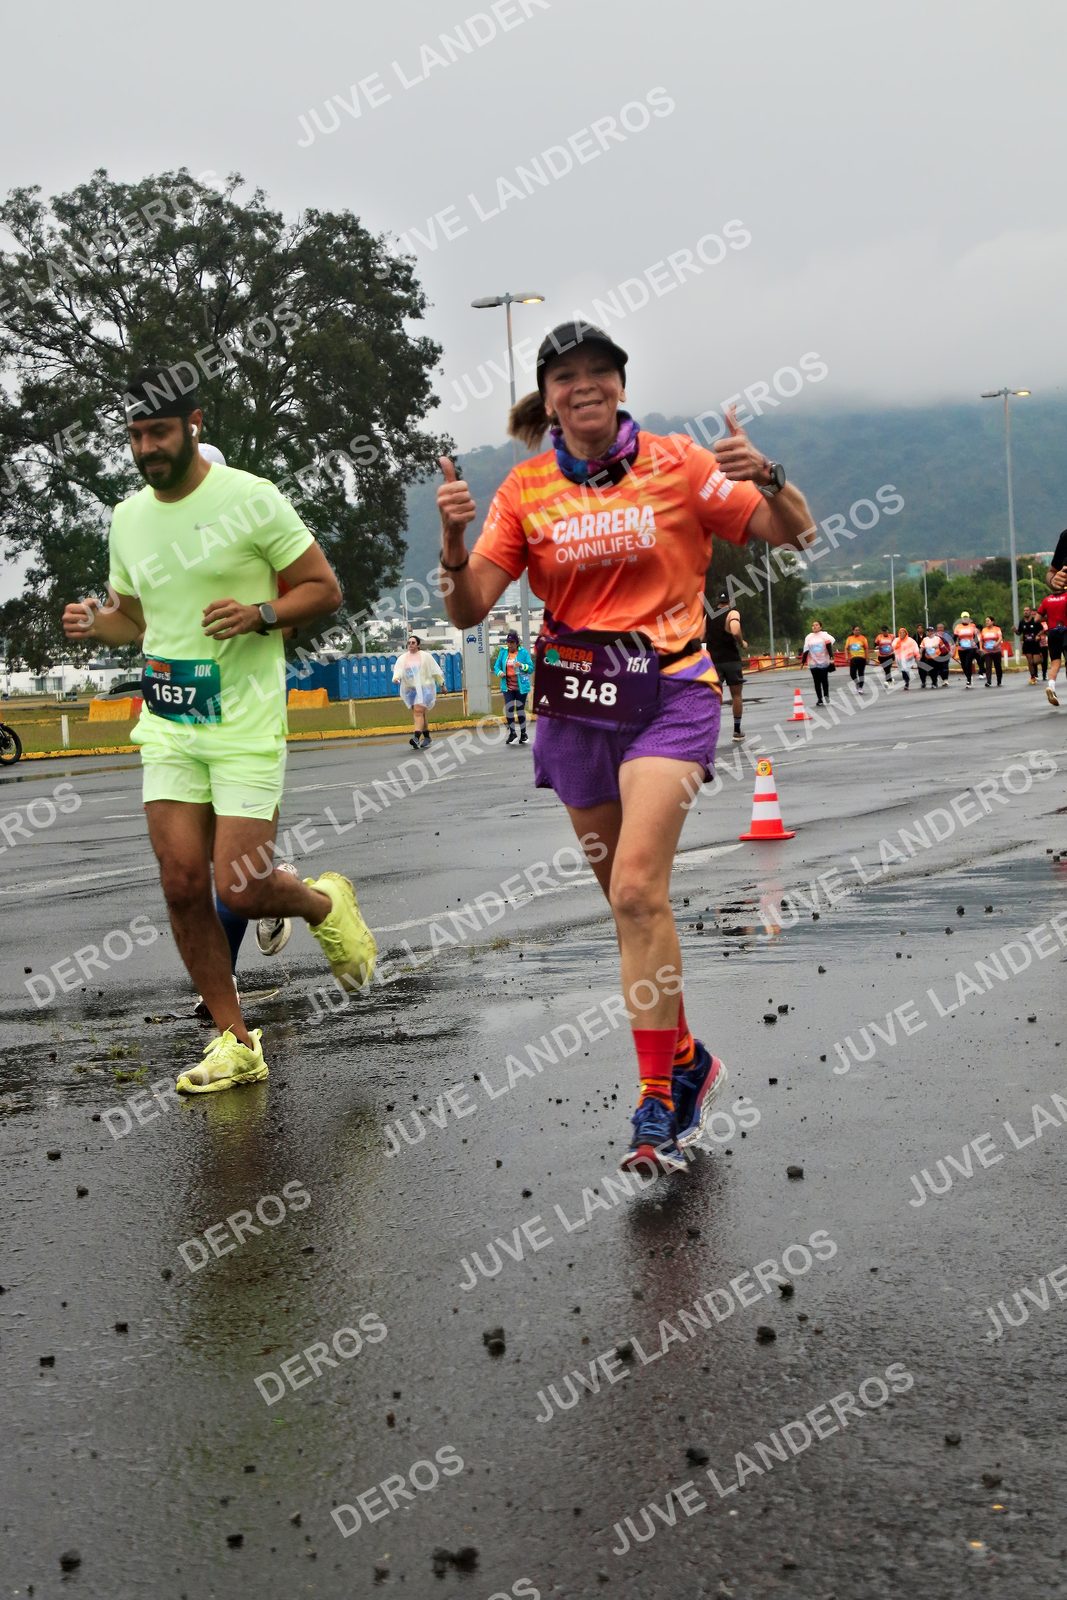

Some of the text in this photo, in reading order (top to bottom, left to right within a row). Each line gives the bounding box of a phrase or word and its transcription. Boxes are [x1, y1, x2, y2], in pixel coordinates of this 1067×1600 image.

[552, 504, 656, 544] CARRERA
[556, 534, 635, 563] OMNILIFE
[194, 665, 211, 678] 10K
[626, 657, 649, 673] 15K
[152, 683, 196, 705] 1637
[564, 676, 617, 705] 348
